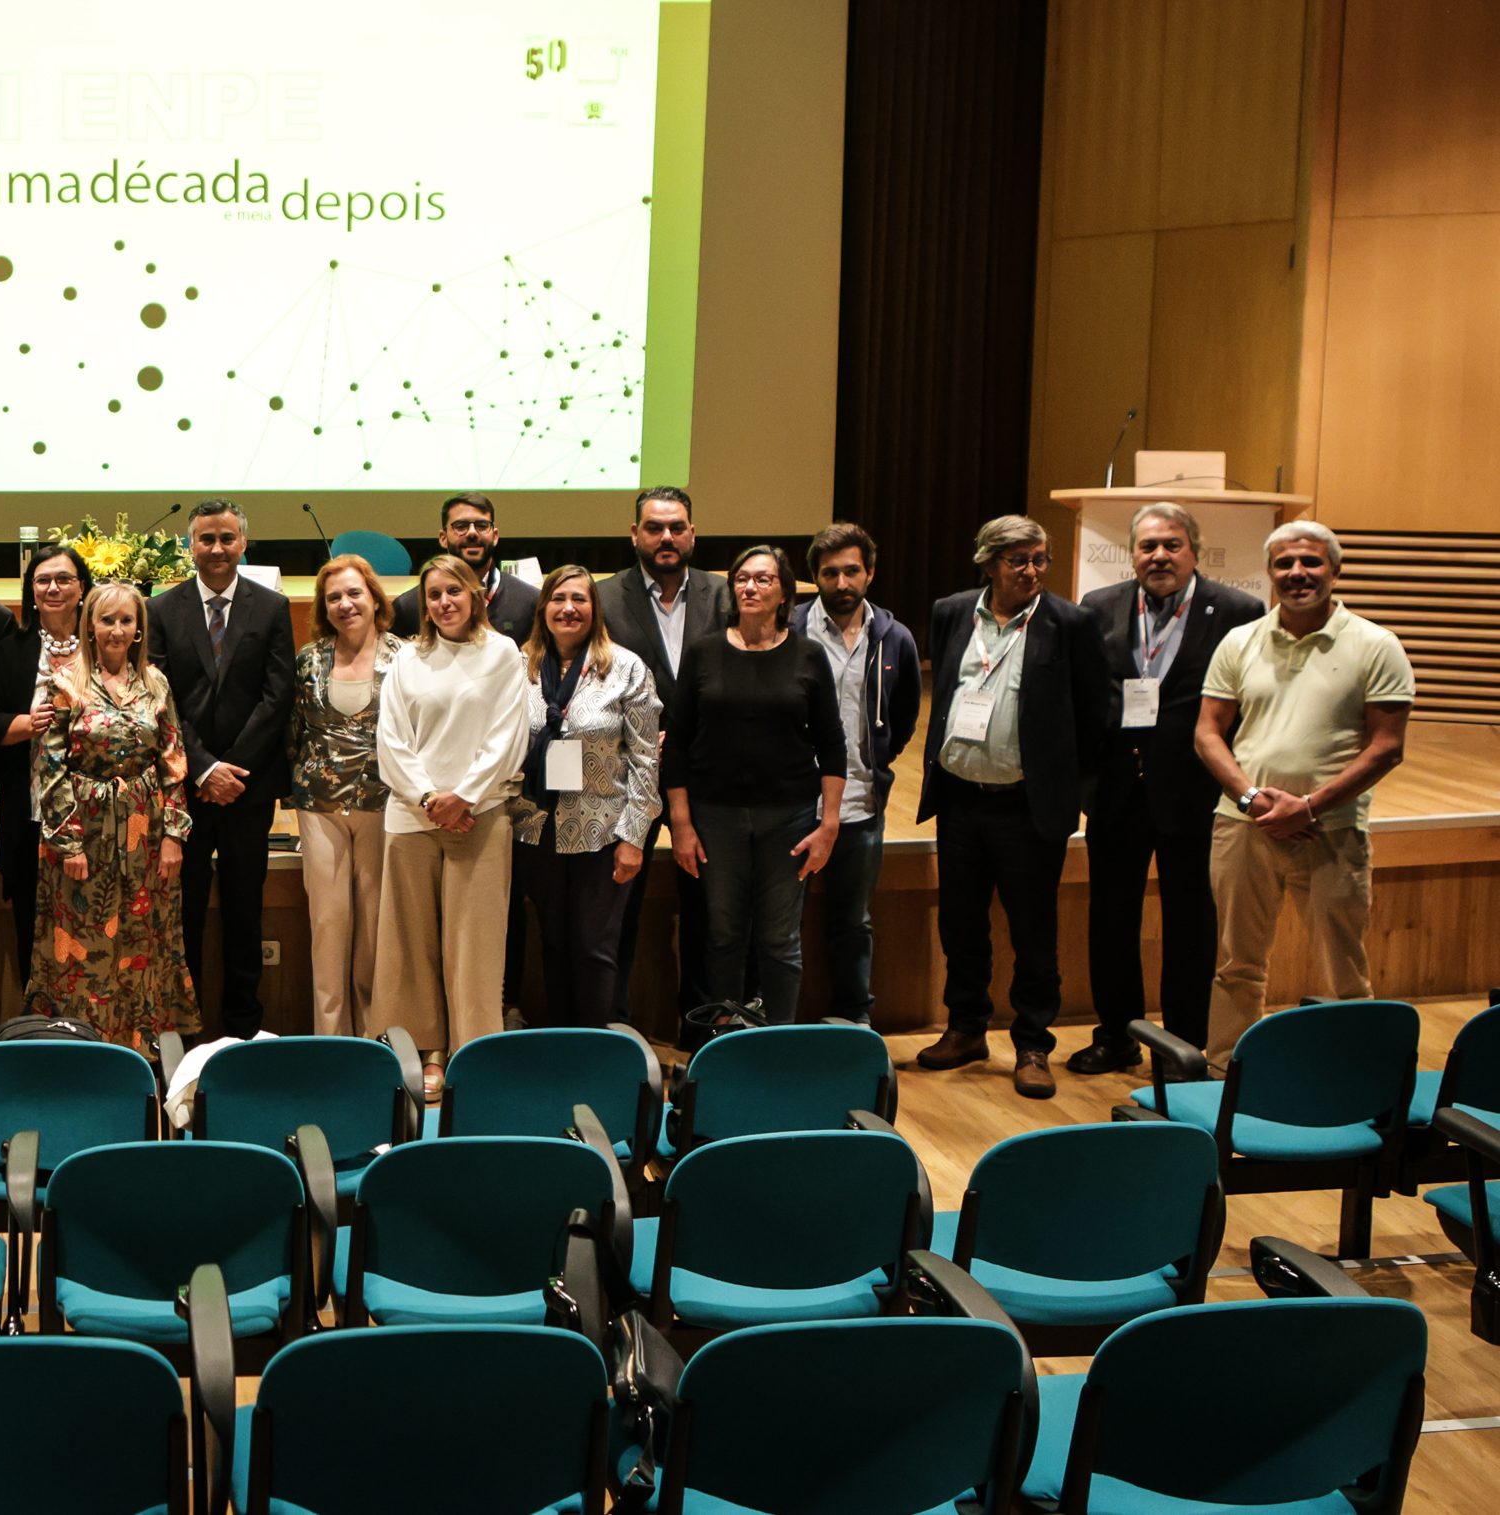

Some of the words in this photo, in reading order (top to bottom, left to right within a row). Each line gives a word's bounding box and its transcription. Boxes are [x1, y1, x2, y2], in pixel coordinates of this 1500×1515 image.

[525, 38, 567, 81] 50
[62, 72, 322, 141] ENPE
[281, 177, 446, 232] depois
